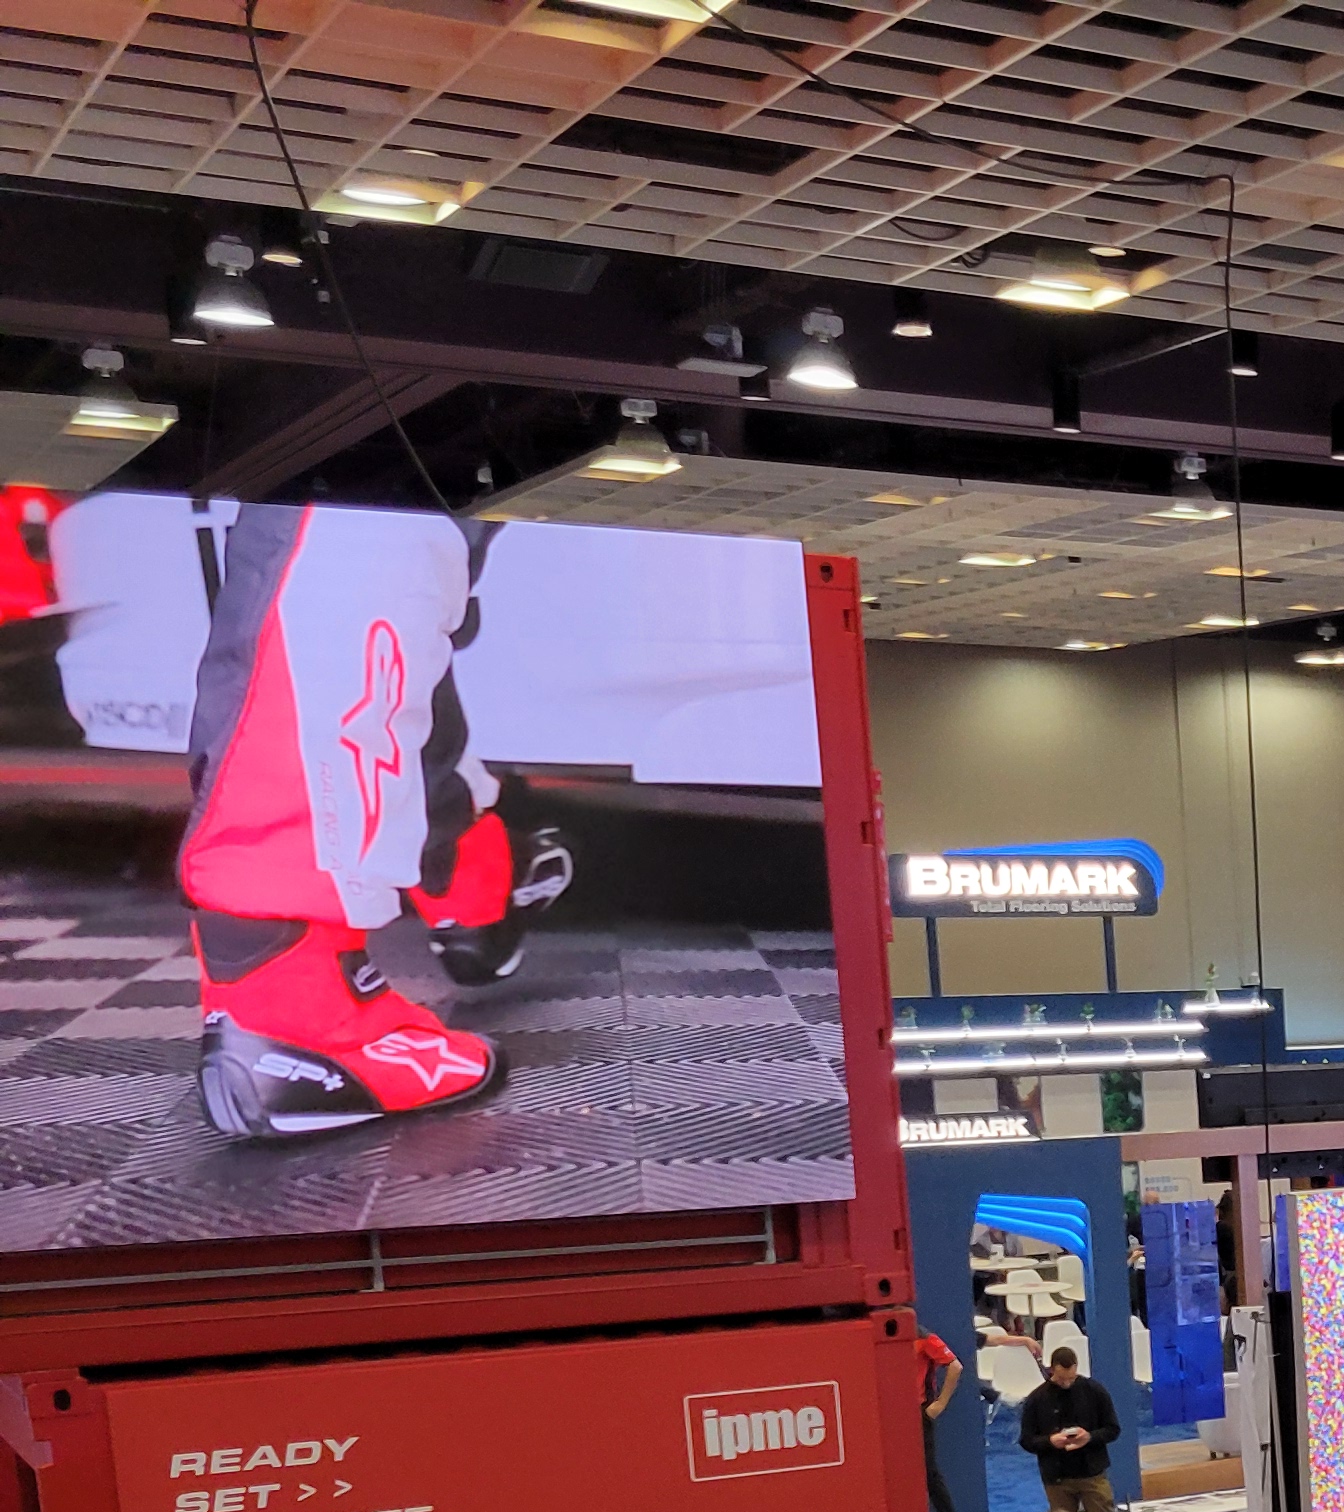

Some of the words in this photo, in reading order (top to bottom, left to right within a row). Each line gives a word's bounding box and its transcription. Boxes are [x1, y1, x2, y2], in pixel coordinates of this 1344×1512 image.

[906, 856, 1138, 896] BRUMARK
[970, 901, 1005, 912] Total
[1009, 901, 1068, 914] Flooring
[1071, 901, 1136, 912] Solutions
[703, 1405, 827, 1461] ipme
[169, 1436, 361, 1479] READY
